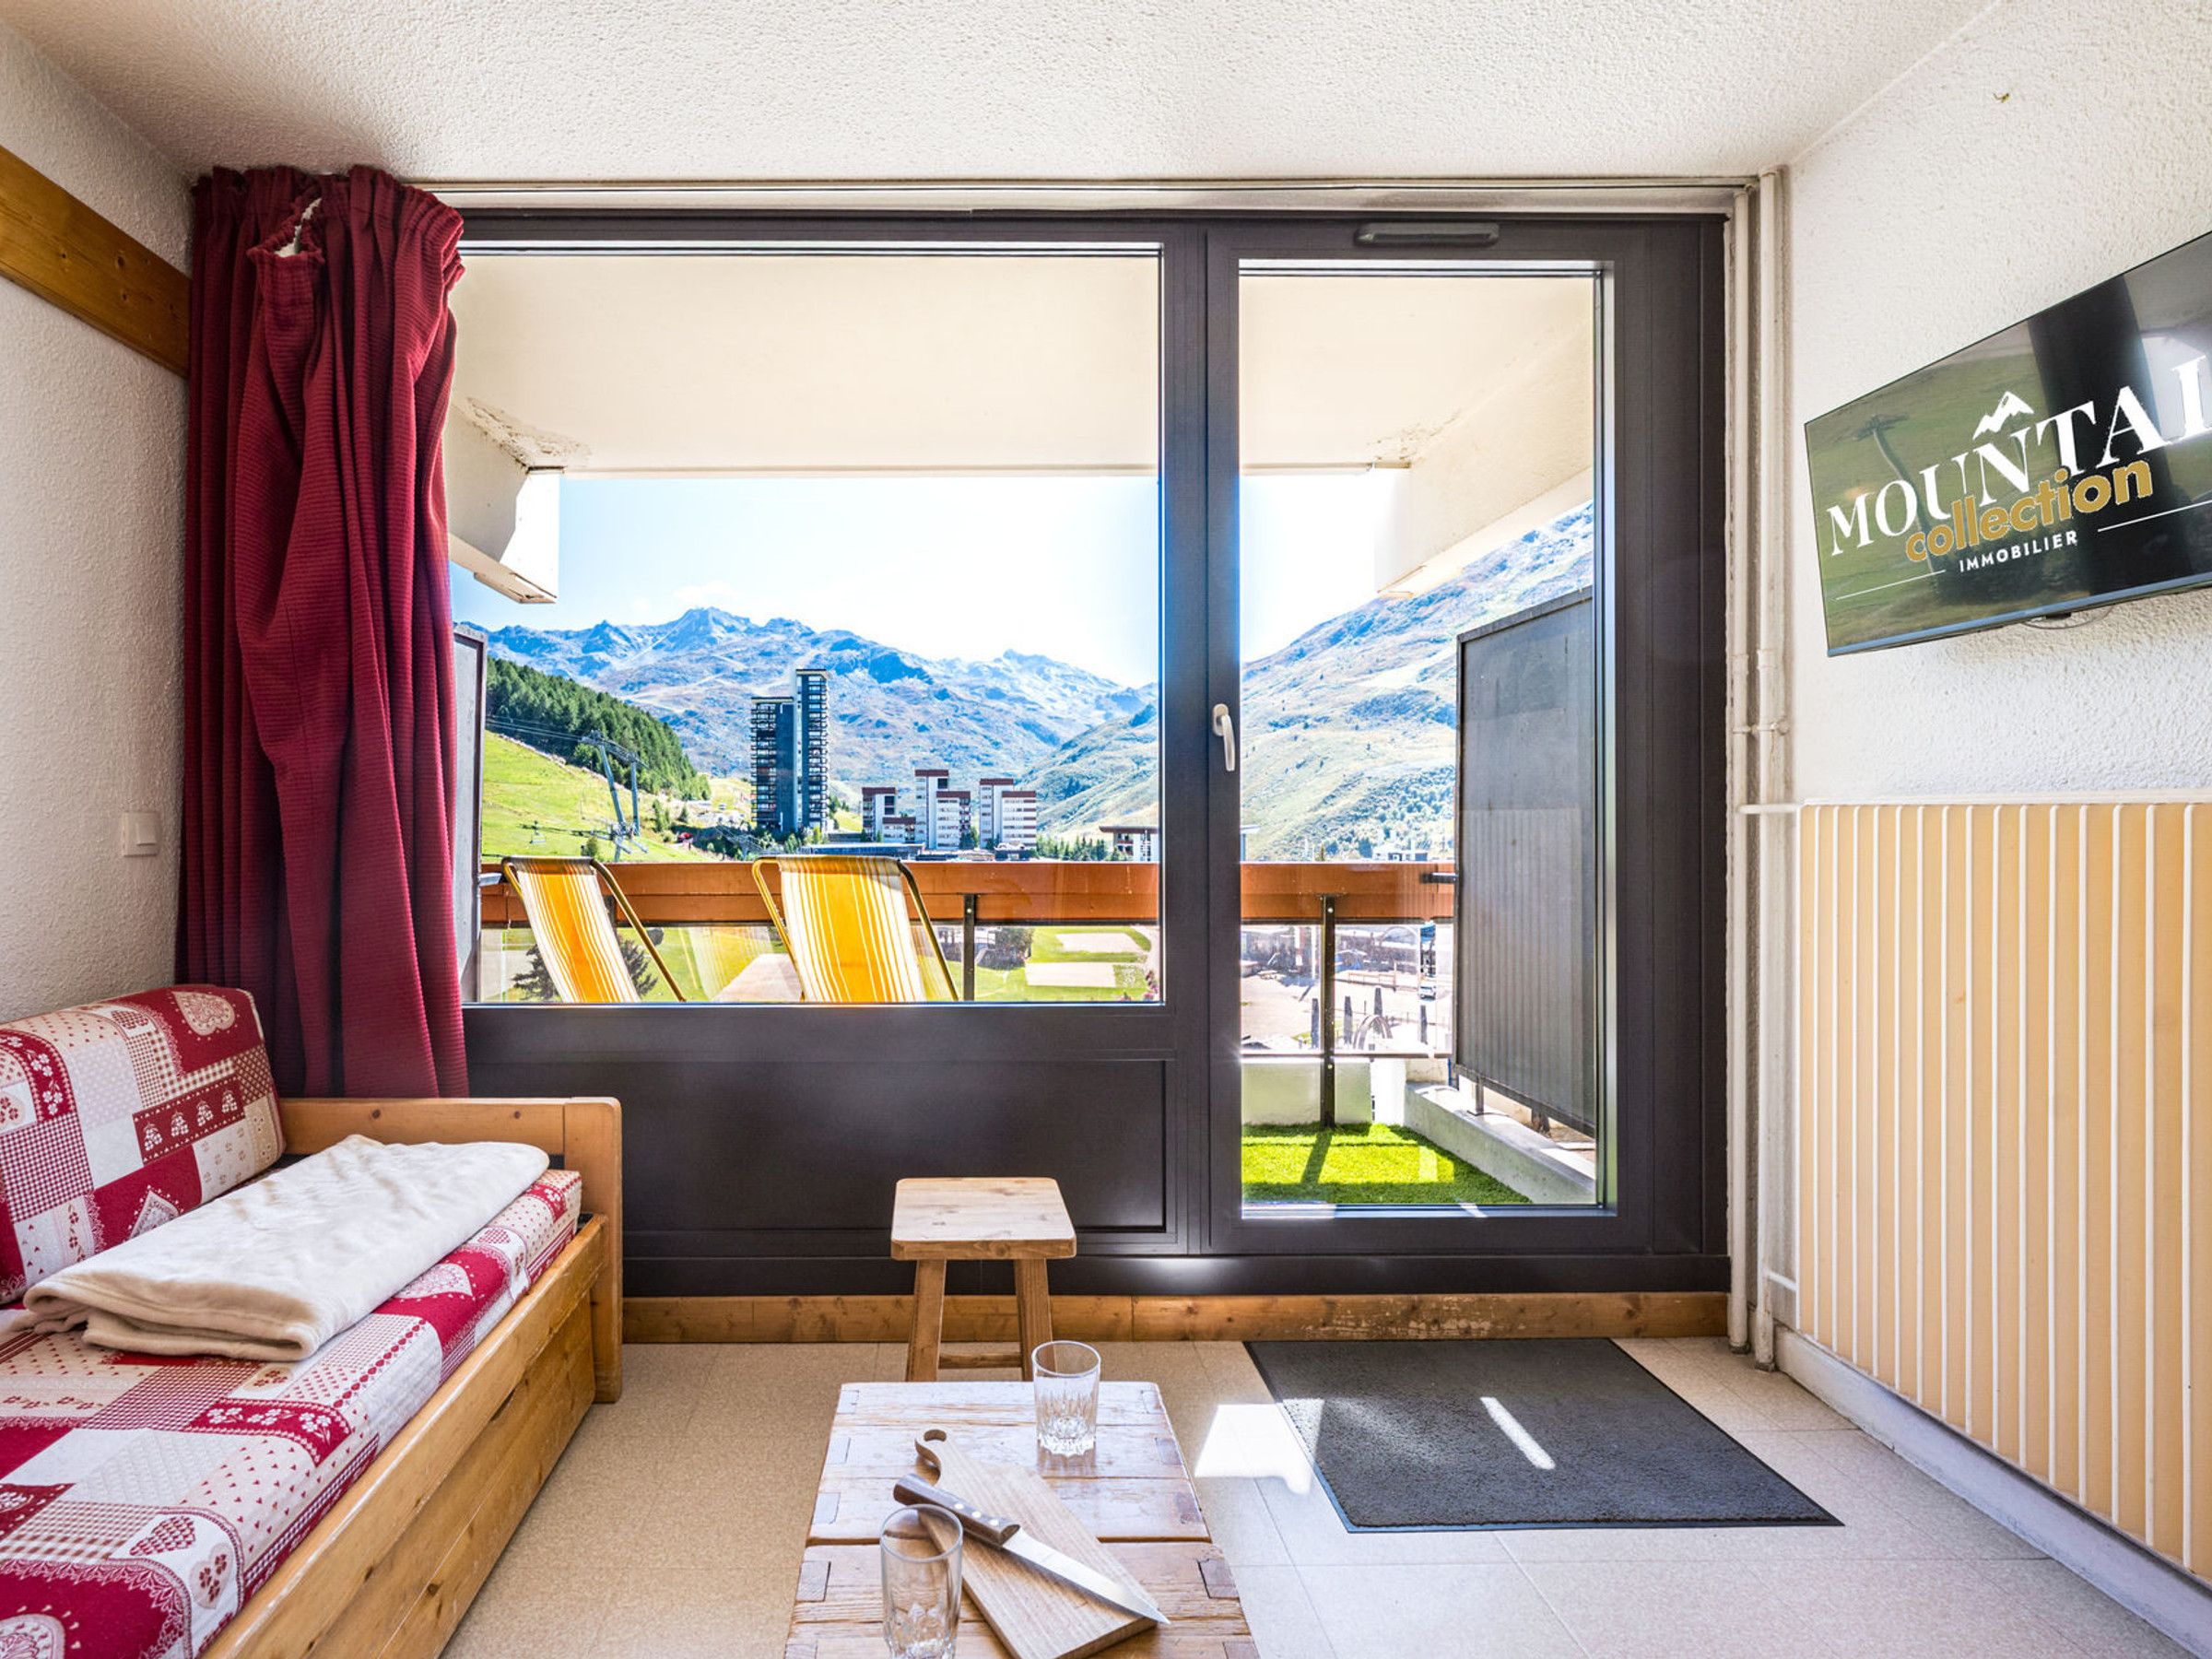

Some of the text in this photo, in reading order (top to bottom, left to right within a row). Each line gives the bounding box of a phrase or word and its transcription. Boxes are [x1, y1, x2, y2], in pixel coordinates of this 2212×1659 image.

[1827, 355, 2212, 556] MOUNTAI
[1905, 460, 2153, 562] collection
[1959, 530, 2078, 573] IMMOBILIER
